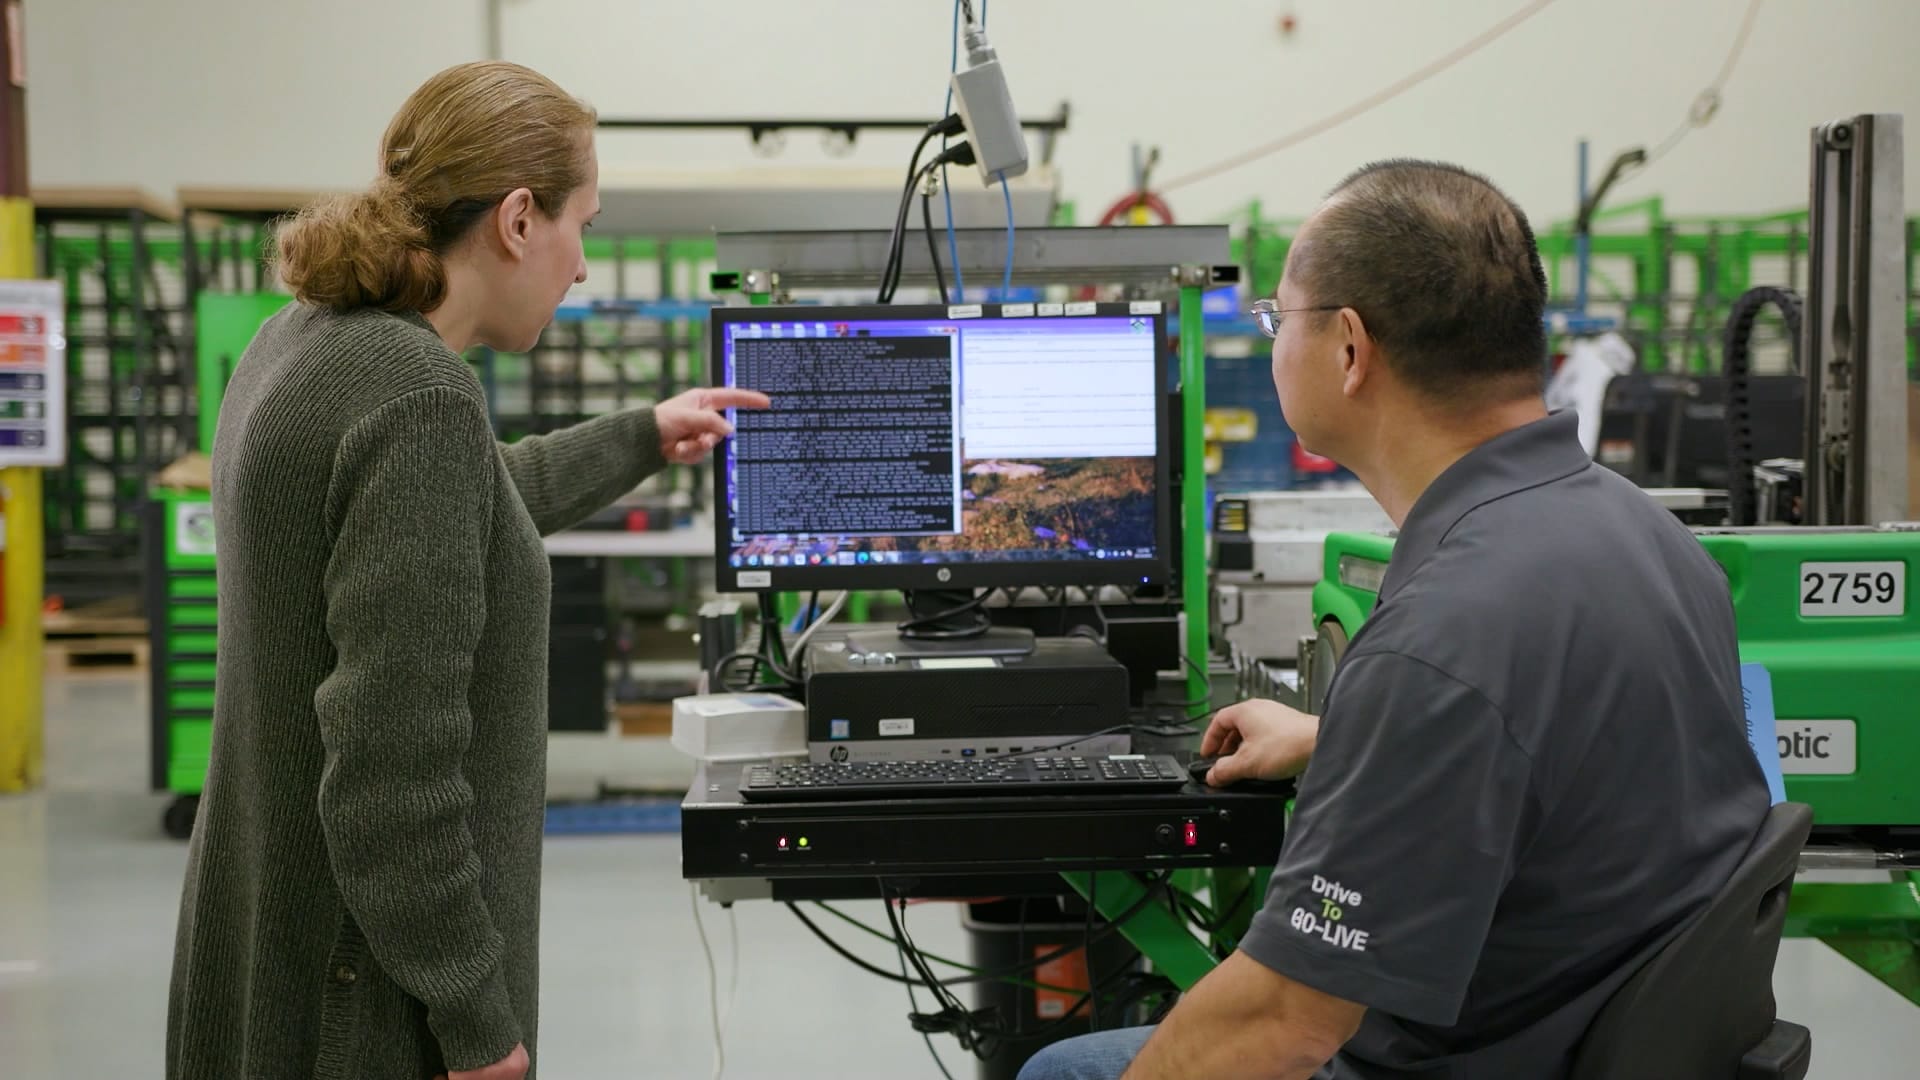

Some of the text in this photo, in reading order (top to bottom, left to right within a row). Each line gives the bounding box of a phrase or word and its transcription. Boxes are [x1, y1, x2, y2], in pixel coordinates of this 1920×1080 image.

[1803, 572, 1895, 604] 2759
[1311, 874, 1362, 906] Drive
[1321, 898, 1342, 920] To
[1291, 906, 1369, 952] GO-LIVE
